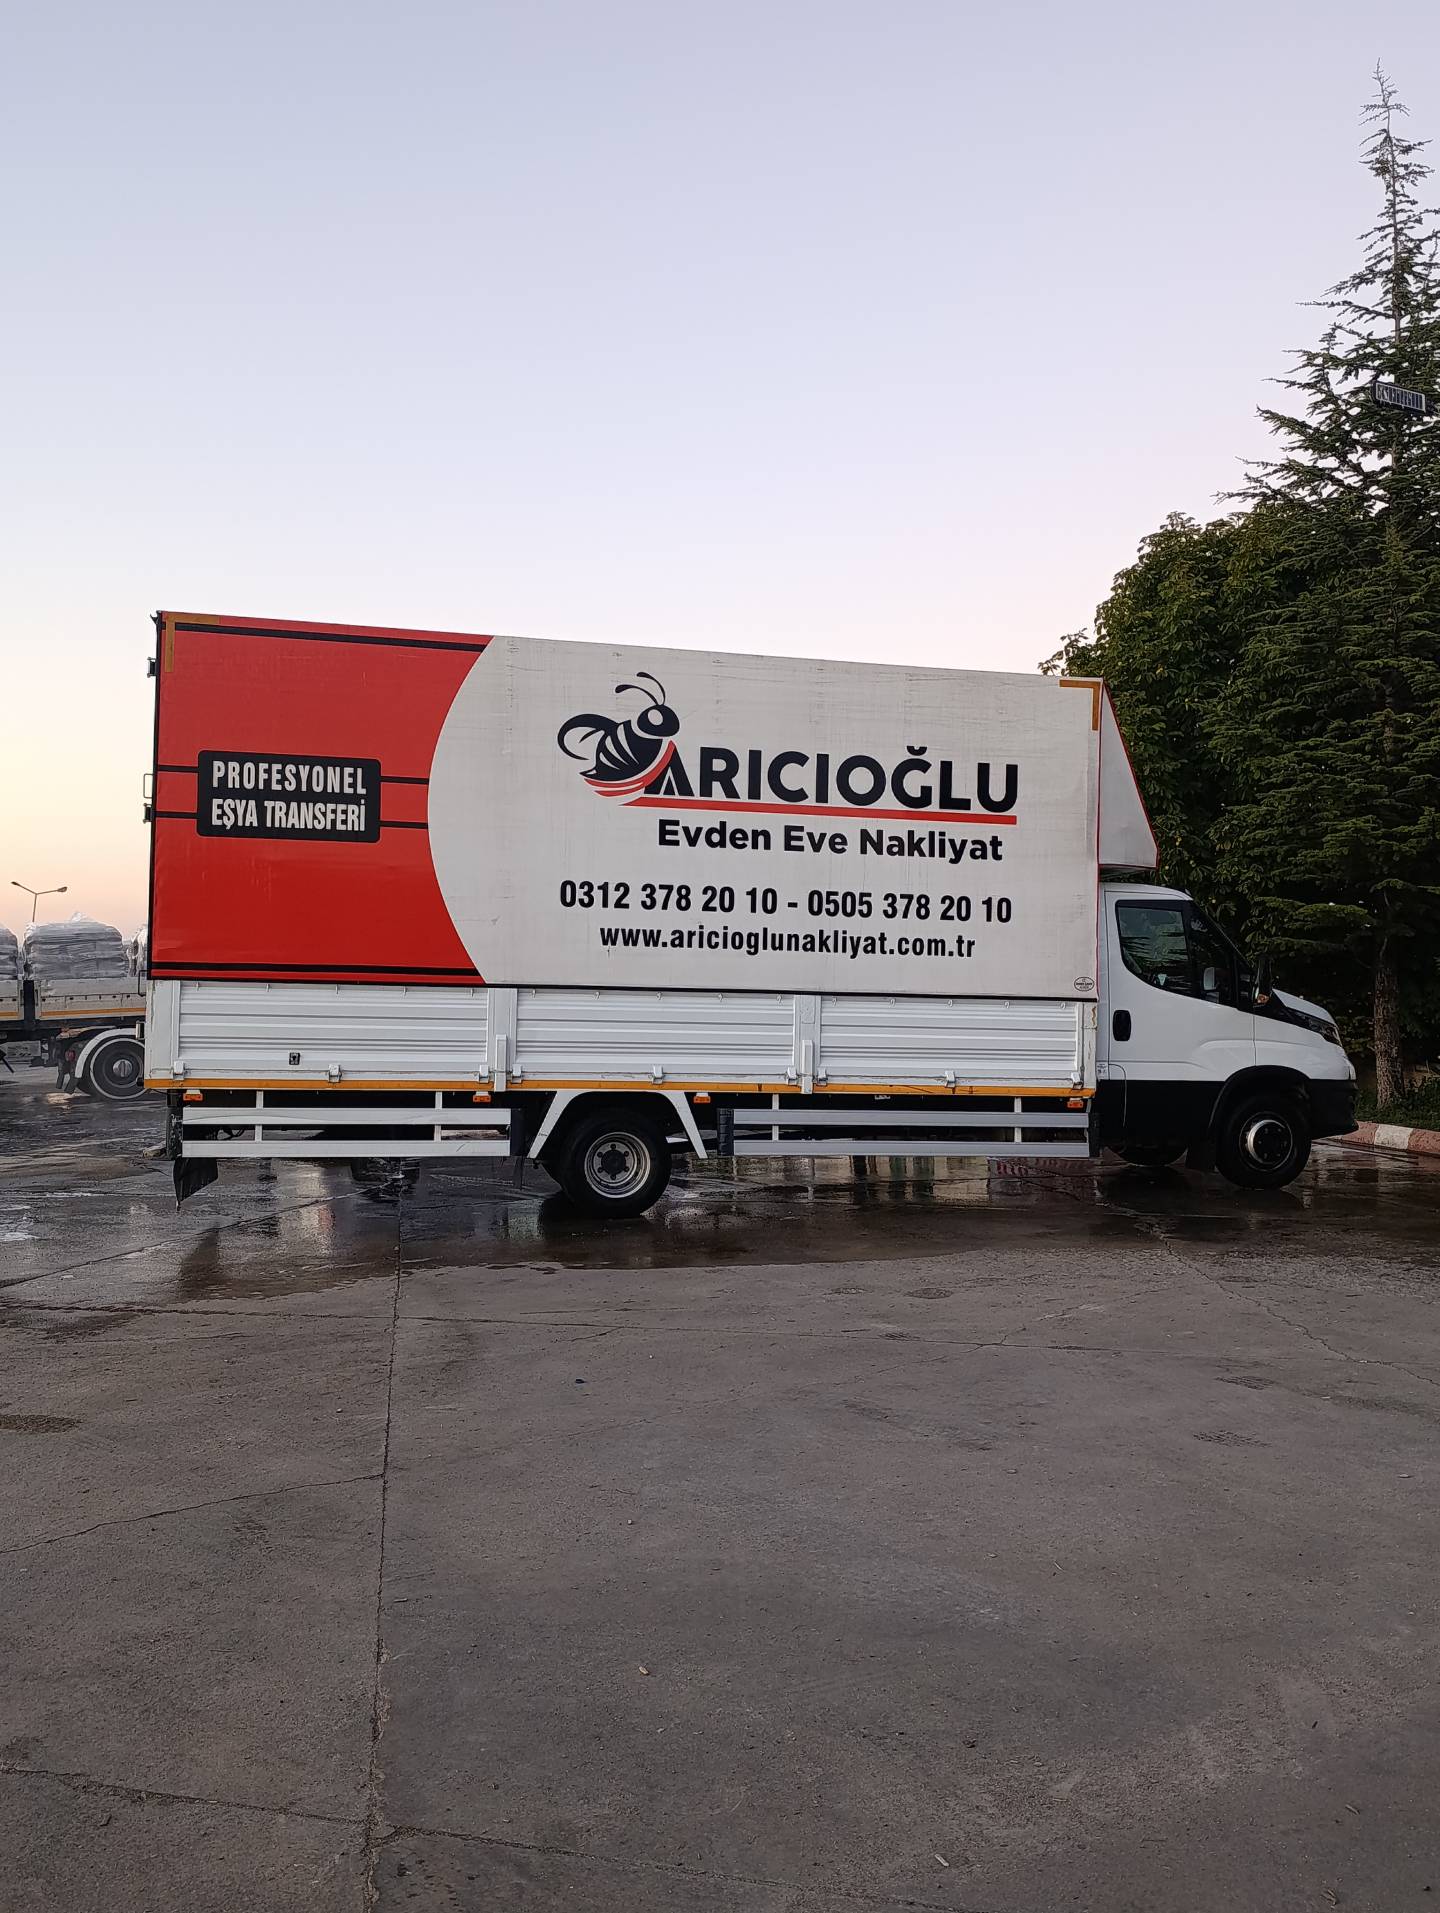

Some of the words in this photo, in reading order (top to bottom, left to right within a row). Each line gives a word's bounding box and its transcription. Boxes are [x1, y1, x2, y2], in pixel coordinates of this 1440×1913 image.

[212, 760, 367, 795] PROFESYONEL
[645, 742, 1019, 814] ARICIOĞLU
[211, 798, 258, 830] EŞYA
[263, 799, 366, 832] TRANSFERİ
[658, 818, 772, 851] Evden
[783, 824, 848, 855] Eve
[859, 828, 1003, 865] Nakliyat
[560, 879, 630, 910] 0312
[640, 883, 692, 912] 378
[701, 885, 735, 913] 20
[745, 887, 778, 915] 10
[807, 889, 873, 919] 0505
[882, 892, 931, 921] 378
[939, 894, 972, 922] 20
[981, 896, 1012, 924] 10
[599, 924, 976, 960] www.aricioglunakliyat.com.tr
